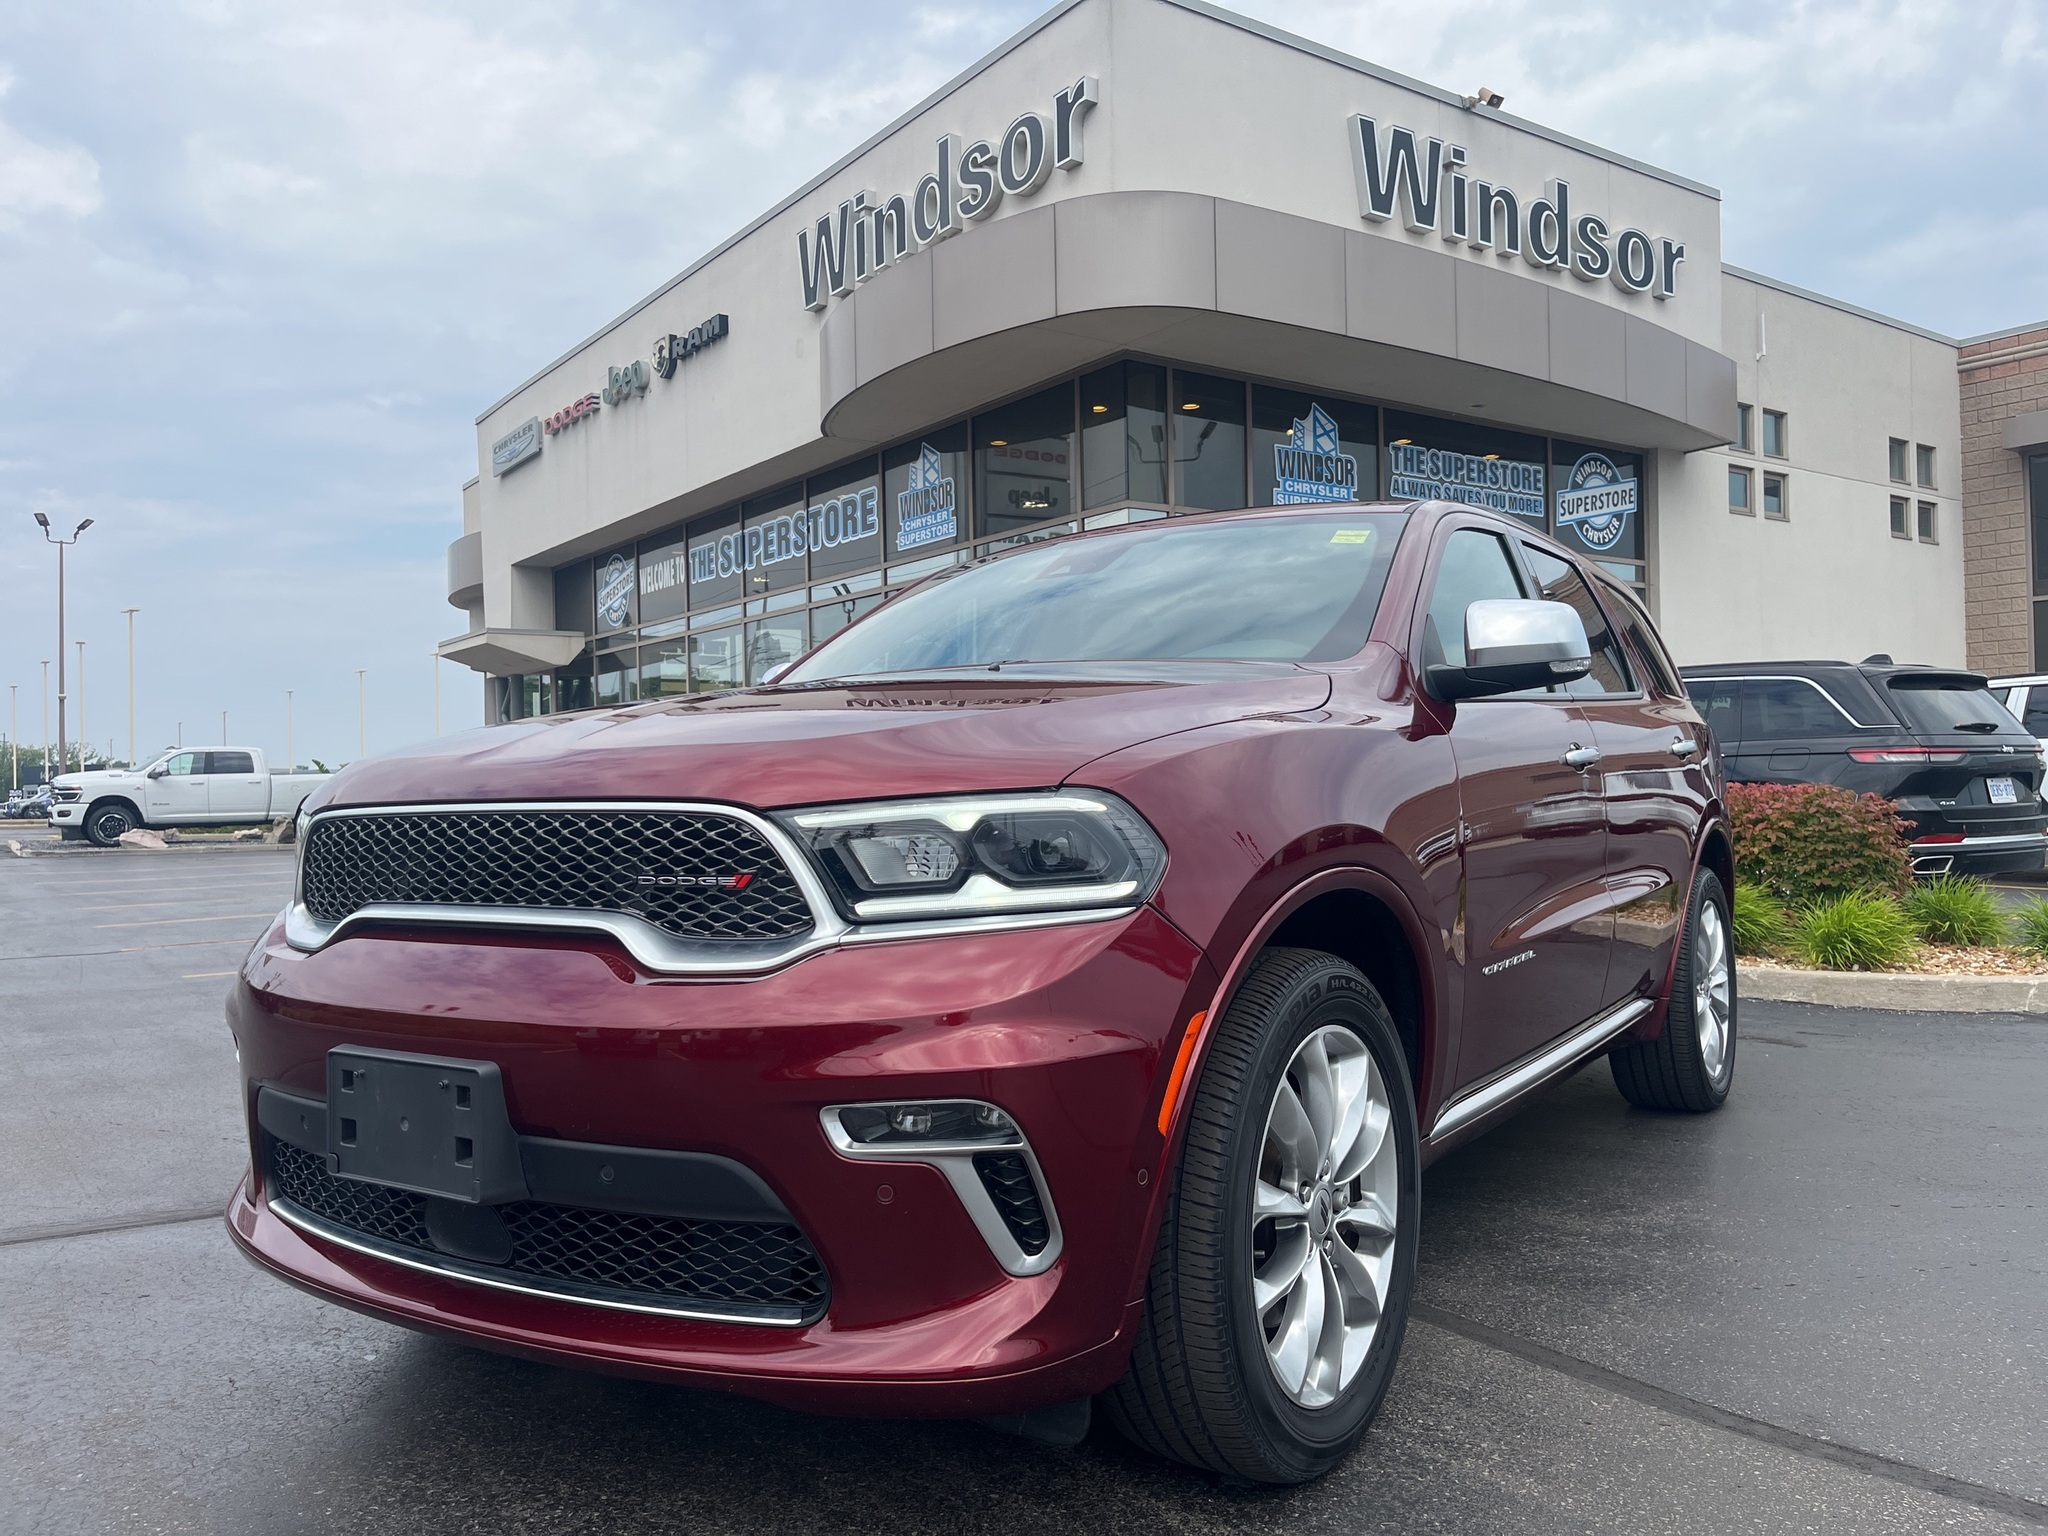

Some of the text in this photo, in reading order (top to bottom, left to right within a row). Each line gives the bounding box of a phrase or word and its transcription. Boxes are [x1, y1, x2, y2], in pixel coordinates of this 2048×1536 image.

[796, 75, 1098, 313] Windsor
[1347, 112, 1686, 301] Windsor
[672, 313, 729, 361] RAM
[602, 359, 650, 407] Jeep
[544, 392, 600, 435] DODGE
[493, 423, 534, 455] CHRYSLER
[1276, 448, 1357, 487] WINDSOR
[1390, 443, 1543, 494] THE SUPERSTORE
[1574, 460, 1613, 485] WINDSOR
[899, 480, 954, 521] WINDSOR
[1285, 480, 1348, 499] CHRYSLER
[1391, 476, 1544, 515] ALWAYS SAVES YOU MORE!
[1560, 487, 1634, 517] SUPERSTORE
[640, 485, 879, 595] WELCOME TO THE SUPERSTORE
[899, 521, 955, 547] SUPERSTORE
[904, 511, 948, 532] CHRYSLER
[1582, 517, 1620, 544] CHRYSLER
[599, 569, 634, 611] SUPERSTORE
[637, 875, 737, 886] DODGE
[1482, 949, 1537, 975] CITADEL
[1349, 980, 1368, 997] 422
